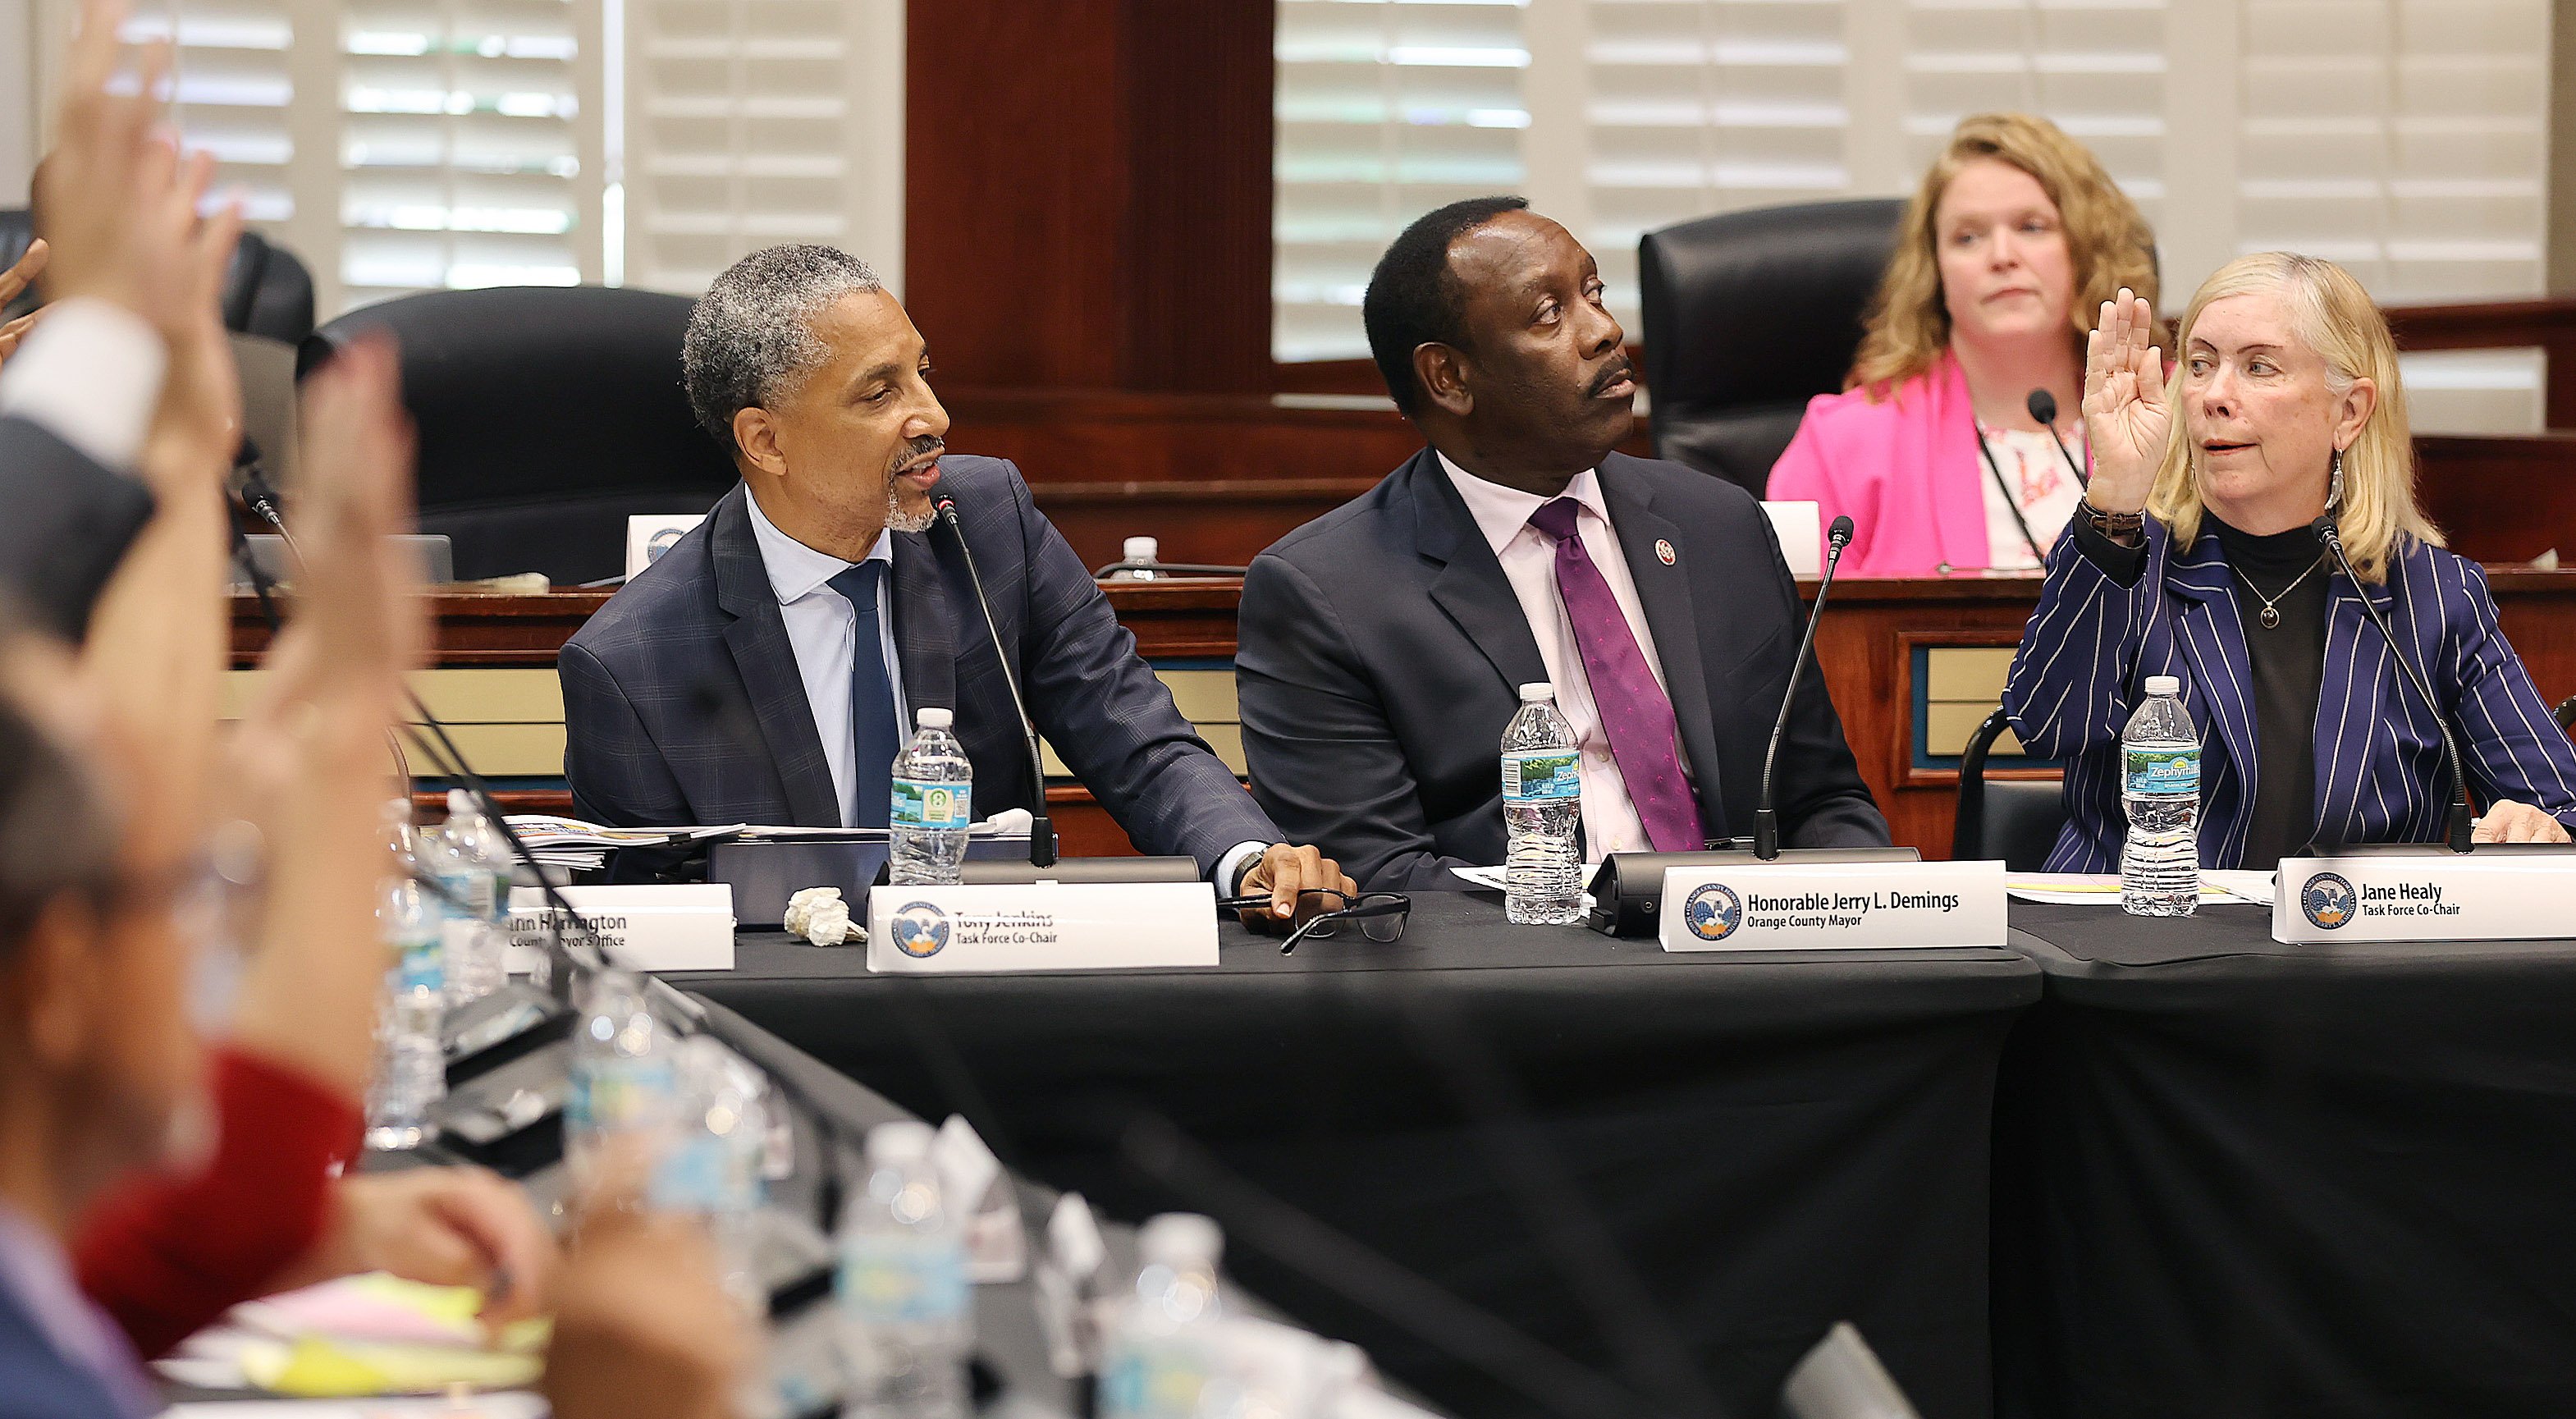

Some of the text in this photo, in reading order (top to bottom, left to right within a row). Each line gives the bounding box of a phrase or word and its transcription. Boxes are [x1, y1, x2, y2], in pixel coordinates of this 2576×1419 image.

[2362, 882, 2441, 904] Jane Healy
[1748, 891, 1959, 913] Honorable Jerry L. Demings
[2362, 904, 2460, 915] Task Force Co-Chair
[1748, 914, 1862, 930] Orange County Mayor
[509, 936, 547, 947] Count
[955, 932, 1057, 944] Task Force Co-Chair
